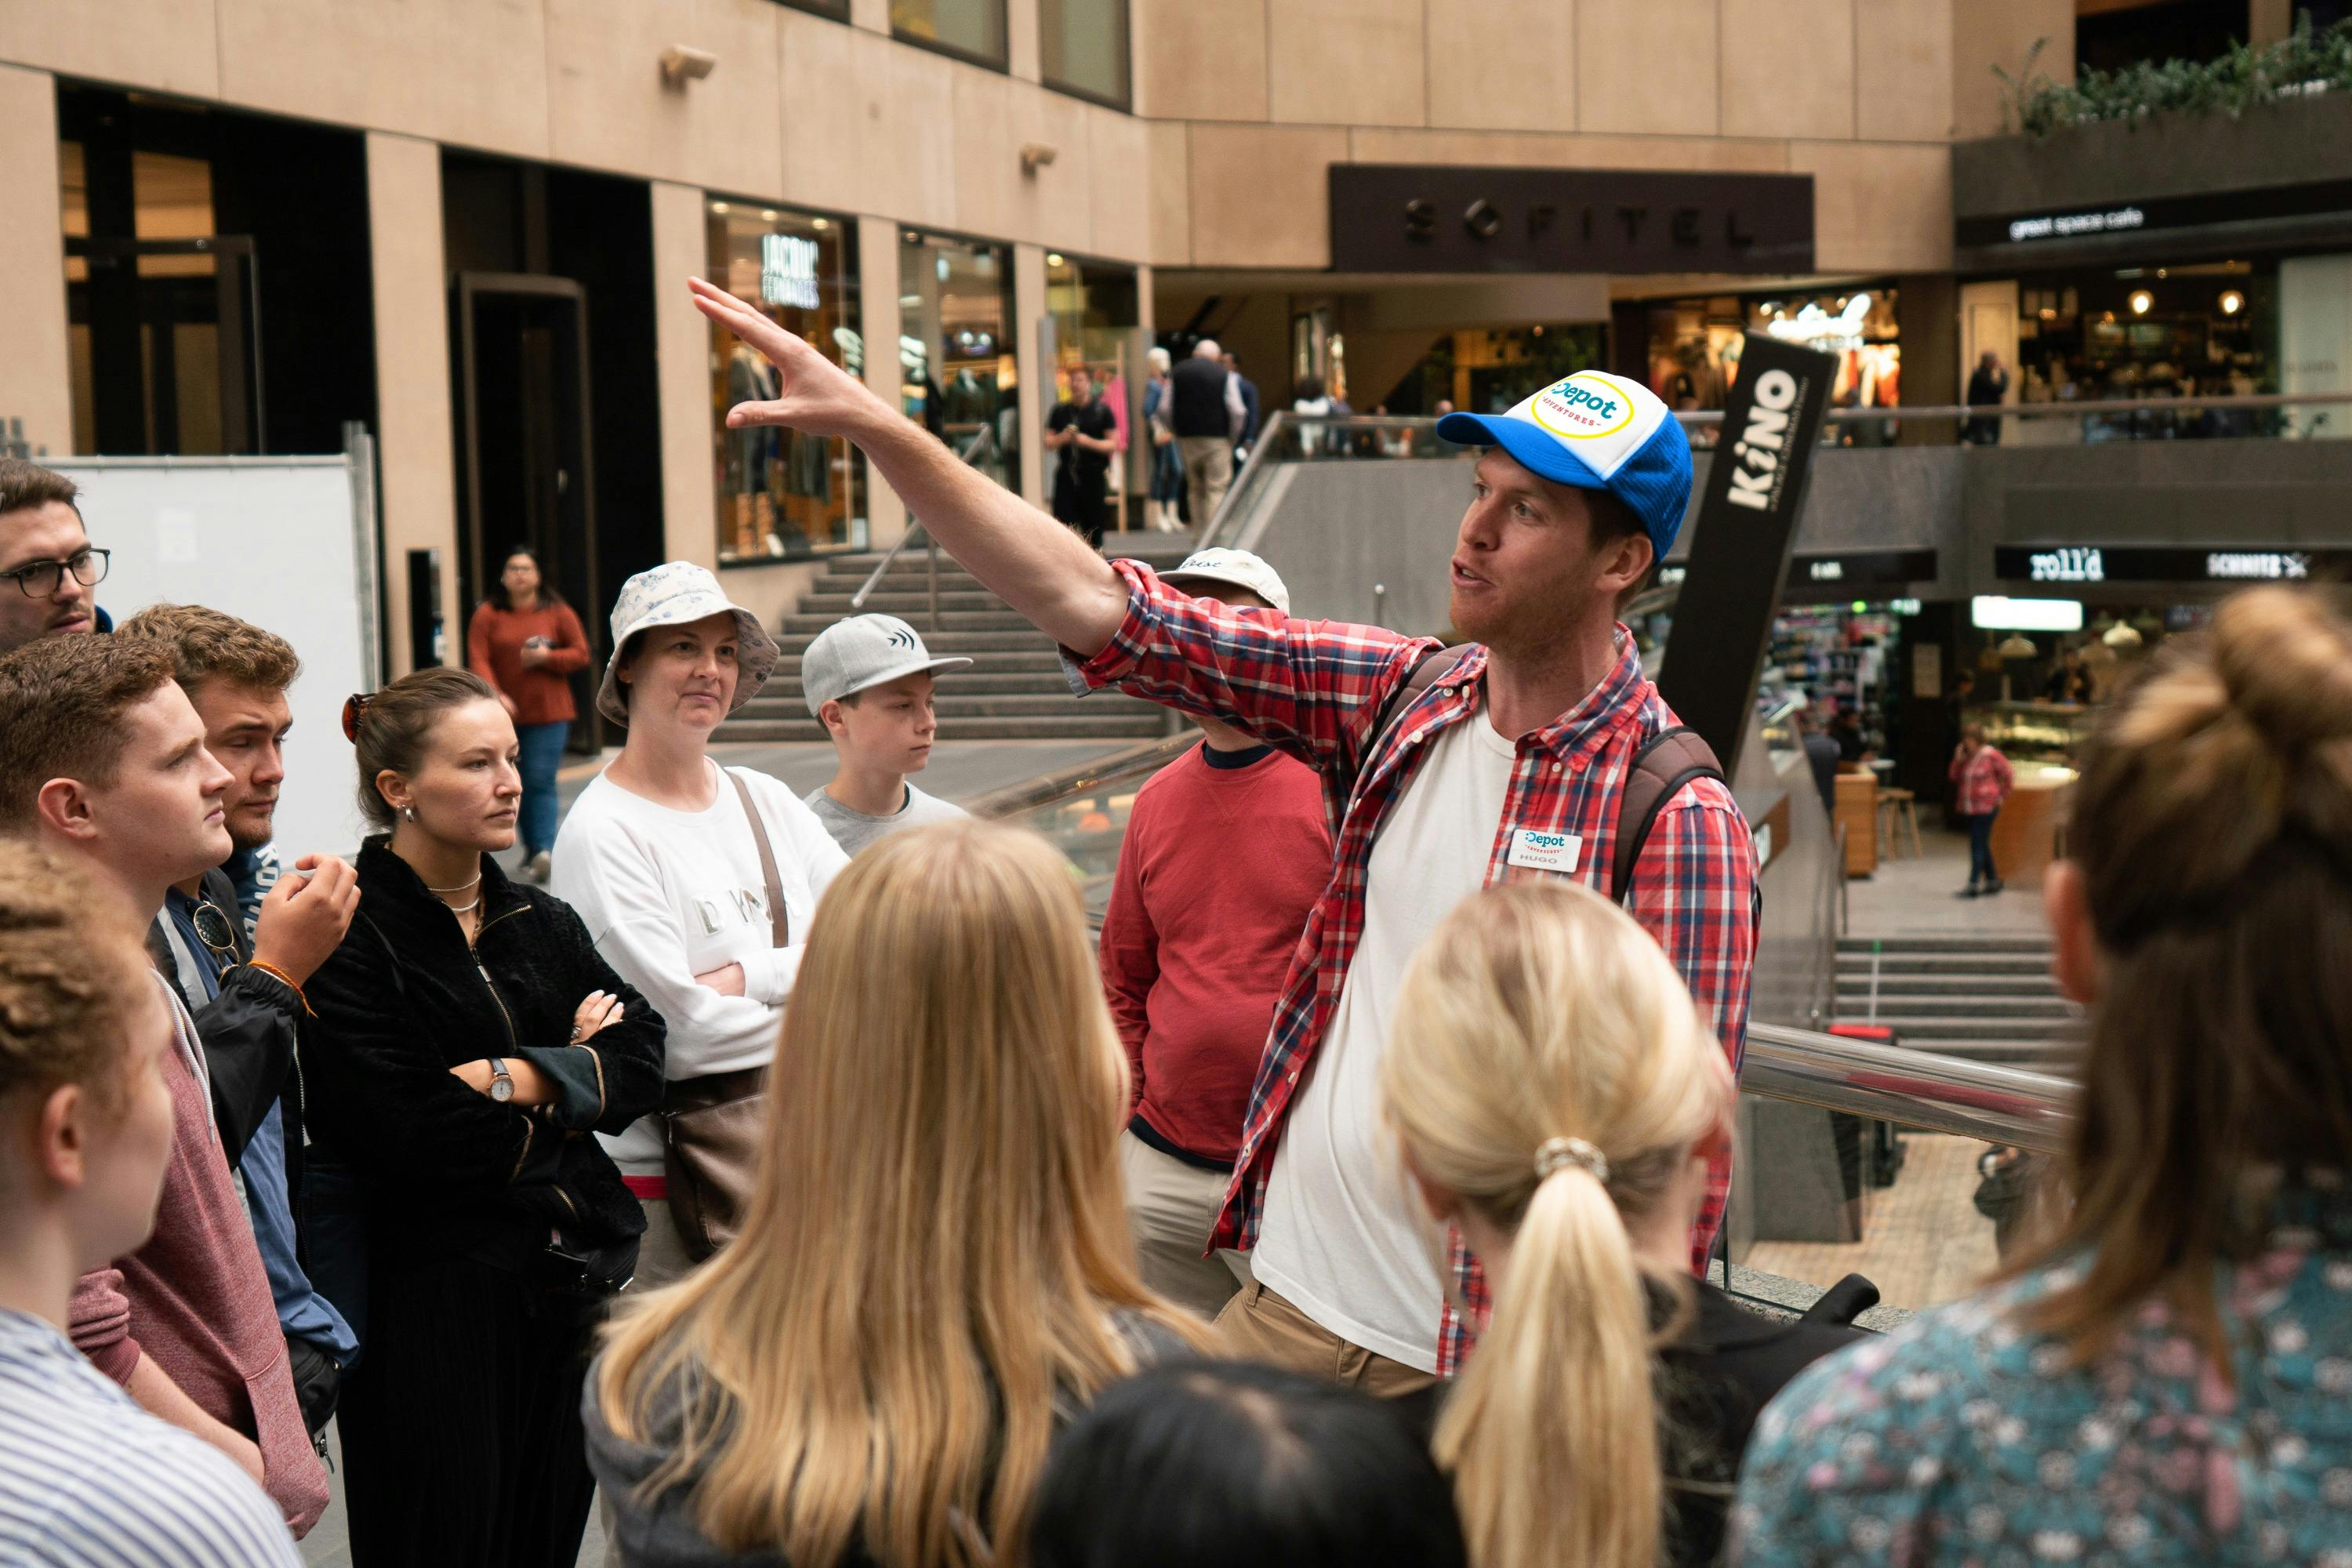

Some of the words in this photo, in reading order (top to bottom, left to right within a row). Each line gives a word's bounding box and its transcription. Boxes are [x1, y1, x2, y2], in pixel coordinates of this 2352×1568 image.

[1405, 198, 1753, 247] SOFITEL
[1542, 397, 1595, 426] ADVENTURES
[1524, 831, 1565, 848] Depot
[1519, 853, 1558, 864] HUGO
